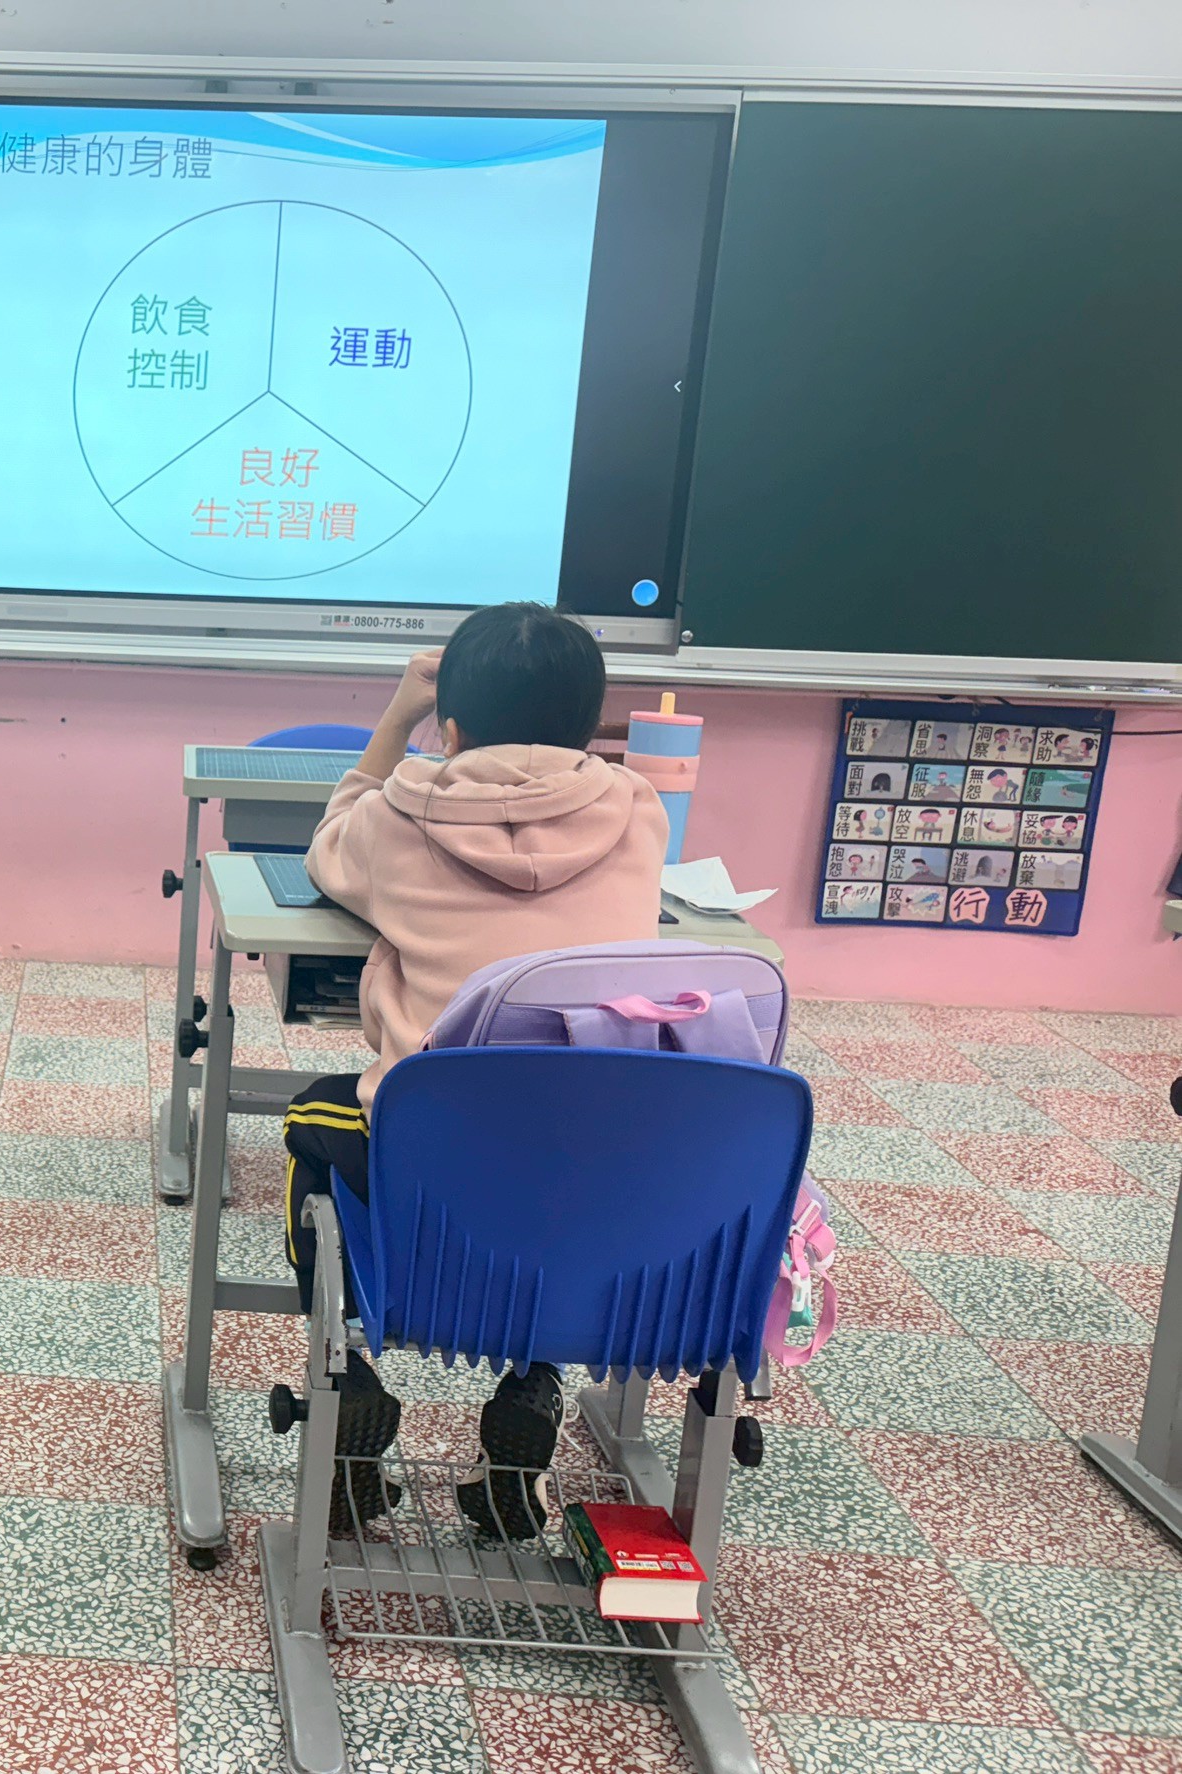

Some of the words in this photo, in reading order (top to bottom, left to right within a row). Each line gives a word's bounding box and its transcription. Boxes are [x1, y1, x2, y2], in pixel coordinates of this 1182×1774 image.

[130, 292, 214, 338] 飲食
[328, 326, 414, 370] 運動
[126, 348, 210, 392] 控制
[240, 447, 320, 488] 良好
[190, 497, 359, 542] 生活習慣
[850, 720, 866, 753] 挑戰
[913, 723, 932, 756] 省思
[973, 726, 993, 758] 洞察
[1037, 730, 1055, 762] 求助
[847, 764, 865, 796] 面對
[911, 766, 931, 798] 征服
[966, 768, 984, 800] 無怨
[1026, 771, 1046, 803] 隨緣
[836, 805, 852, 838] 等待
[893, 808, 913, 840] 放空
[960, 810, 978, 842] 休息
[1022, 813, 1039, 845] 妥協
[829, 846, 845, 878] 抱怨
[889, 848, 906, 880] 哭泣
[952, 852, 969, 883] 逃避
[1019, 854, 1037, 886] 放棄
[887, 887, 903, 918] 攻擊
[954, 890, 1043, 923] 行動
